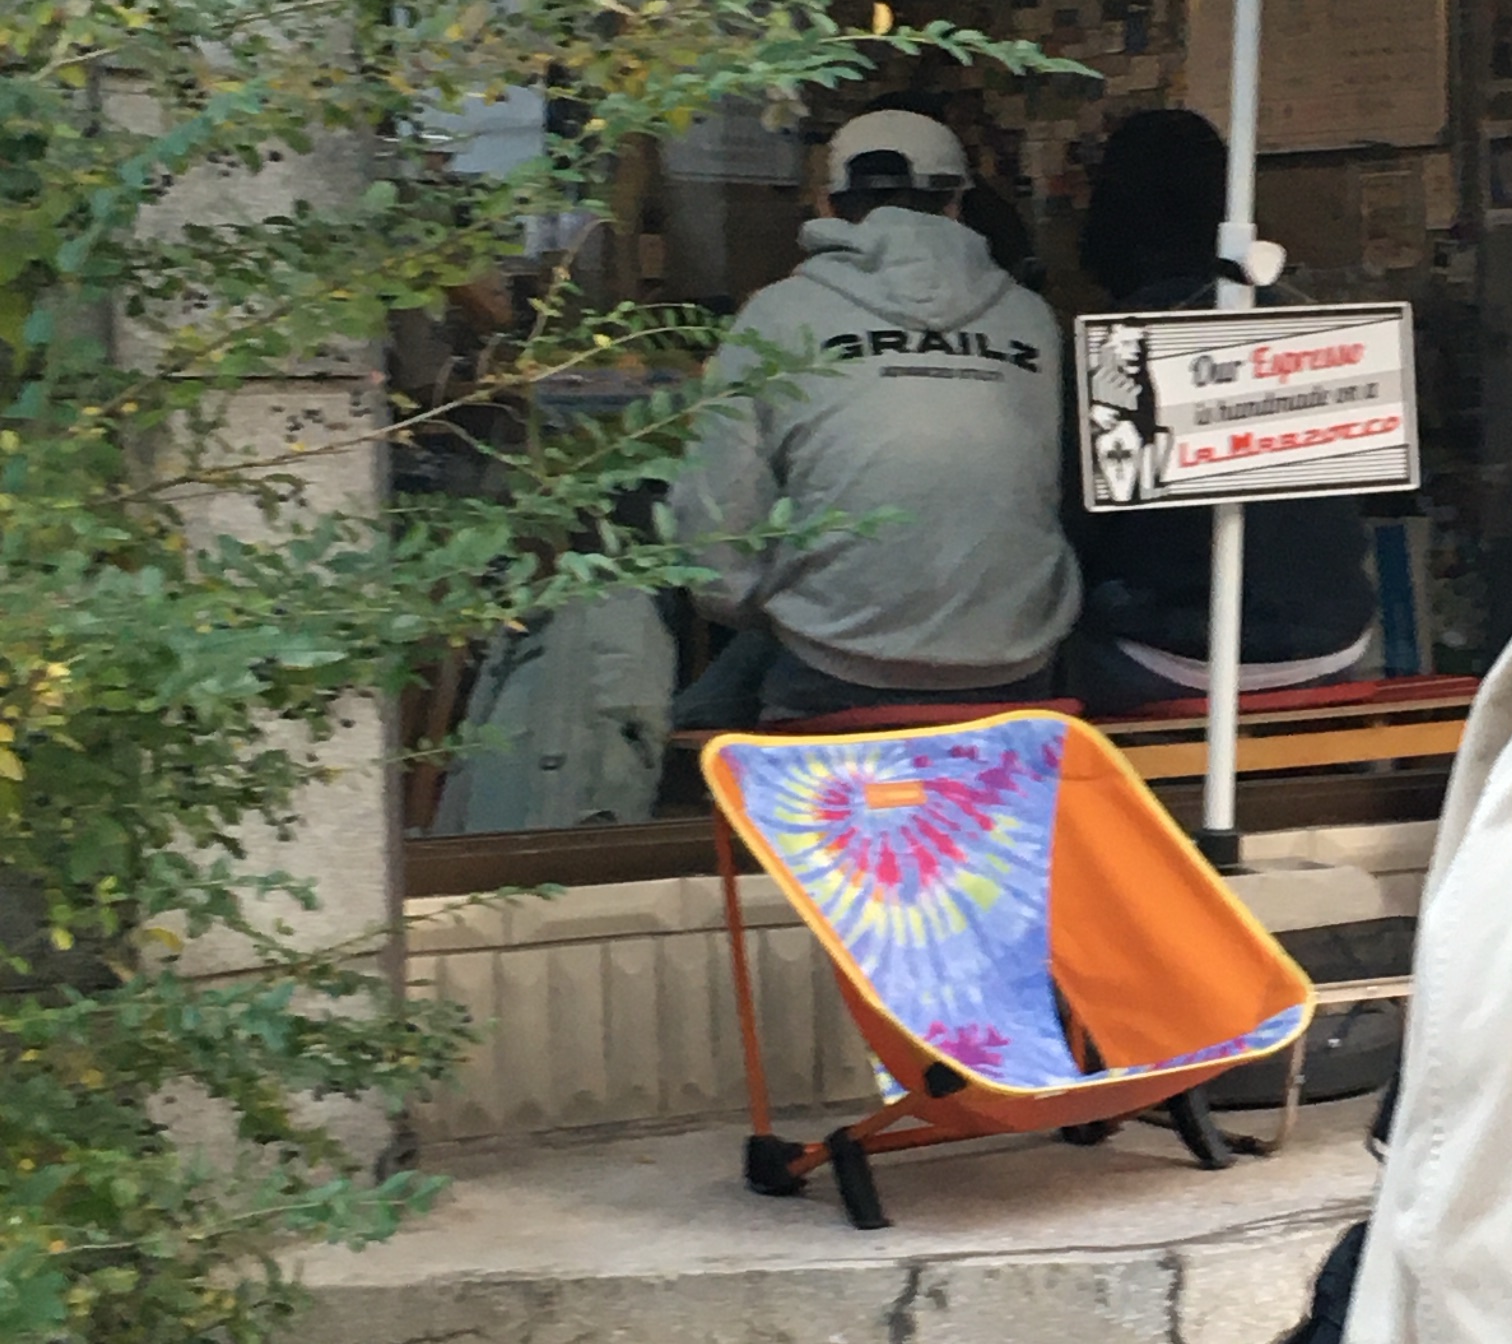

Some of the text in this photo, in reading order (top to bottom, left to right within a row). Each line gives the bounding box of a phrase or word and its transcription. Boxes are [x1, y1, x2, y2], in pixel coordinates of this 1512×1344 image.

[821, 330, 1041, 373] GRAILZ
[1189, 355, 1242, 387] Our
[1178, 442, 1216, 468] La
